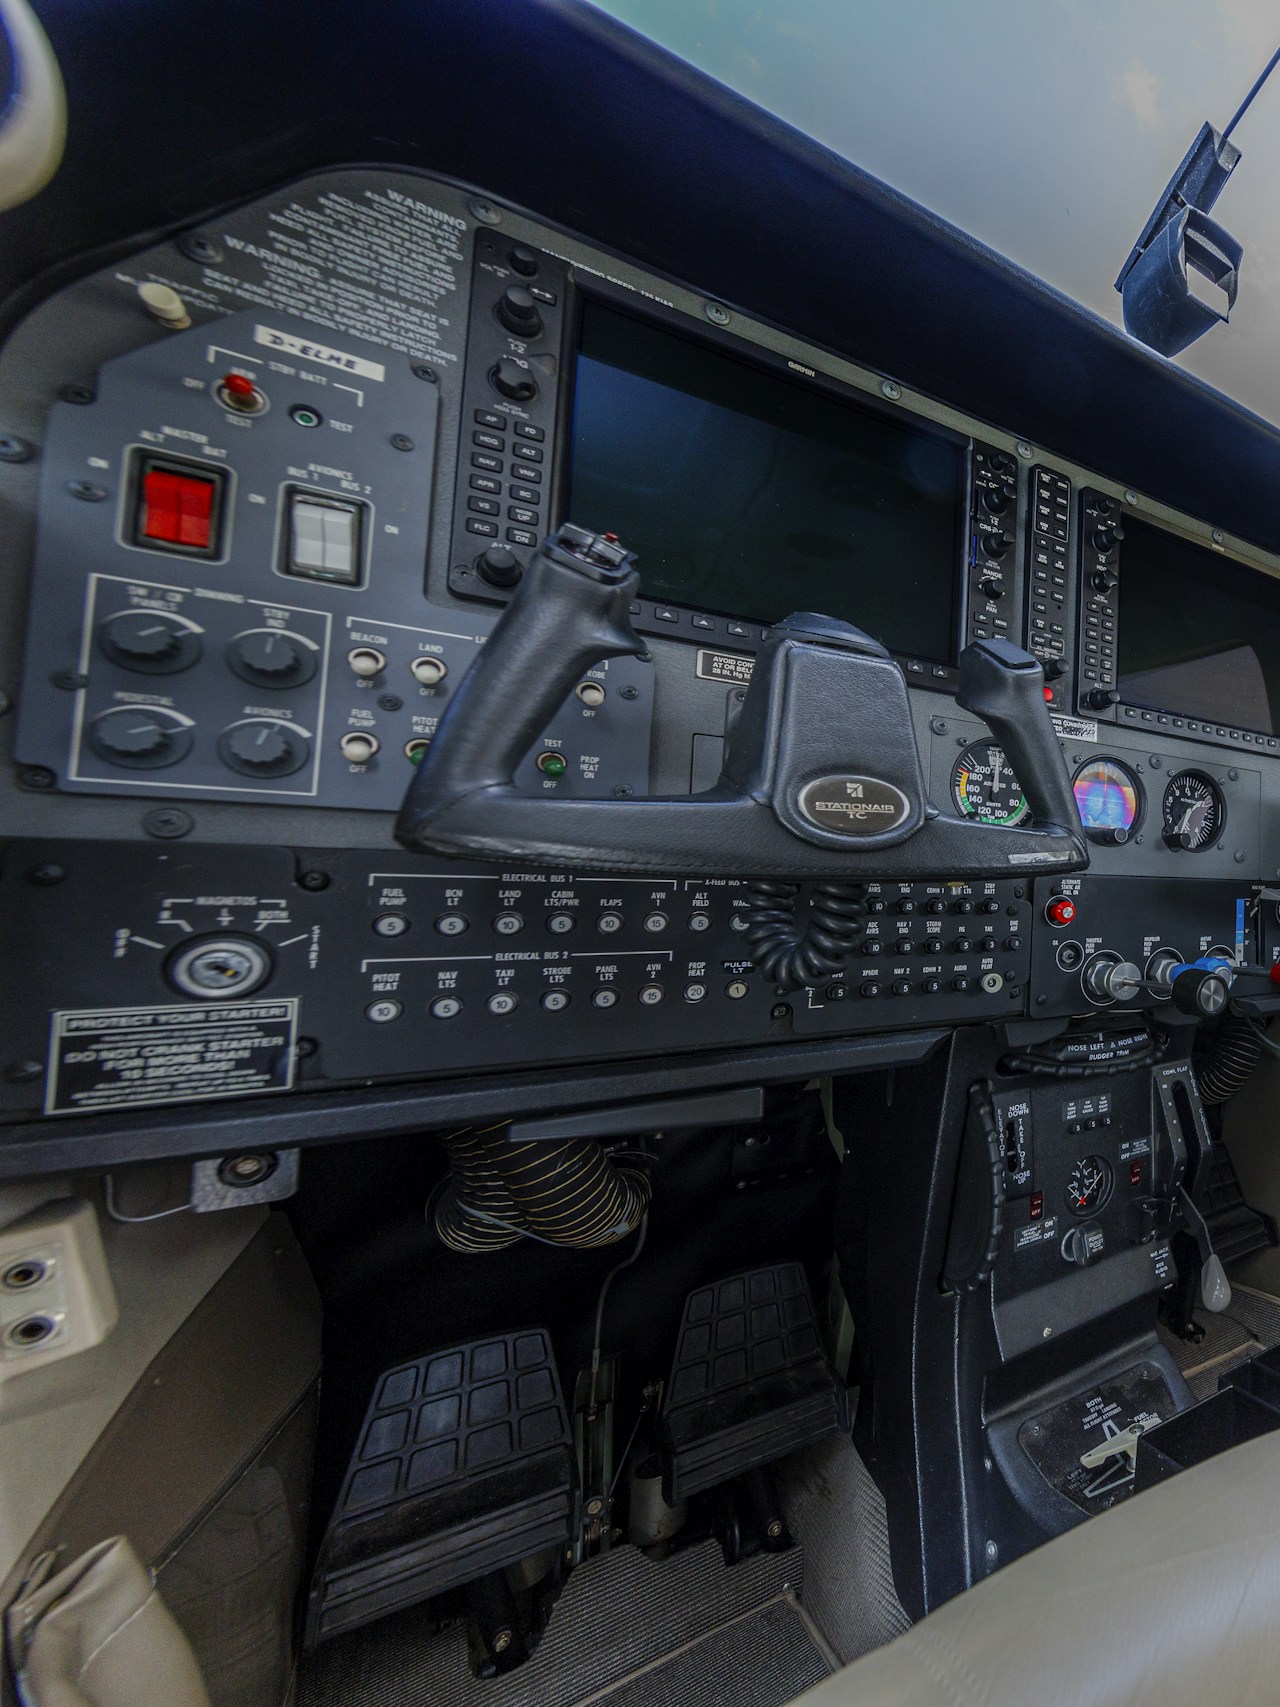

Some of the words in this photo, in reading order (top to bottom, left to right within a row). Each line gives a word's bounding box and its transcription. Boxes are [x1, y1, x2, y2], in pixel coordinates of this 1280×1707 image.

[364, 190, 409, 215] ASSURE
[413, 210, 440, 228] THAT
[442, 221, 462, 237] ALL
[387, 189, 466, 232] WARNING
[329, 192, 391, 224] INCLUDING
[436, 236, 458, 251] ARE
[318, 196, 377, 227] REMOVED
[379, 220, 410, 241] FROM
[412, 234, 440, 252] FUEL
[441, 246, 464, 262] AND
[324, 207, 356, 227] FUEL
[359, 222, 402, 246] SYSTEM
[404, 240, 447, 264] BEFORE
[308, 236, 335, 253] AND
[342, 223, 391, 250] FAILURE
[410, 251, 452, 275] ASSURE
[333, 237, 376, 261] SAFETY
[378, 254, 457, 293] INSTRUCTIONS
[372, 244, 399, 261] FREE
[400, 255, 428, 273] FUEL
[430, 266, 456, 284] AND
[290, 247, 334, 271] BODILY
[336, 264, 379, 288] INJURY
[400, 288, 437, 310] DEATH.
[329, 253, 369, 275] FLIGHT
[371, 269, 395, 285] CAN
[398, 279, 440, 302] RESULT
[332, 285, 384, 313] POSITION
[386, 305, 421, 326] PRIOR
[379, 295, 406, 312] THAT
[408, 305, 436, 323] SEAT
[339, 305, 399, 335] PROPERLY
[400, 327, 436, 348] LATCH
[333, 312, 377, 336] SAFETY
[379, 327, 457, 366] INSTRUCTIONS
[270, 333, 357, 370] D-ELME
[348, 325, 389, 350] INJURY
[409, 347, 448, 369] DEATH.
[788, 360, 815, 378] GARMIN
[300, 370, 328, 386] BATT
[329, 419, 353, 434] TEST
[161, 425, 208, 445] MASTER
[480, 435, 498, 446] HDG
[202, 445, 227, 459] BAT
[521, 447, 536, 456] ALT
[479, 457, 496, 467] NAV
[308, 462, 353, 481] AVIONICS
[477, 478, 494, 488] APR
[386, 525, 398, 535] ON
[983, 569, 1003, 580] RANGE
[263, 607, 291, 621] STBY
[986, 606, 998, 614] PAN
[350, 631, 388, 646] BEACON
[418, 642, 443, 654] LAND
[713, 656, 736, 665] AVOID
[356, 679, 374, 689] OFF
[419, 687, 436, 697] OFF
[113, 690, 176, 708] PEDESTAL
[243, 704, 293, 720] AVIONICS
[351, 709, 373, 719] FUEL
[583, 709, 596, 718] OFF
[348, 717, 376, 728] PUMP
[412, 715, 439, 727] PITOT
[412, 724, 437, 734] HEAT
[544, 739, 562, 749] TEST
[580, 755, 599, 765] PROP
[349, 764, 367, 774] OFF
[580, 763, 599, 772] HEAT
[975, 765, 991, 774] 200
[1002, 767, 1014, 776] 40
[584, 771, 595, 780] ON
[969, 773, 983, 781] 180
[543, 780, 557, 789] OFF
[967, 785, 980, 793] 160
[968, 795, 982, 804] 140
[1009, 799, 1019, 807] 80
[815, 800, 894, 812] STATIONAIR
[978, 806, 991, 815] 120
[846, 810, 867, 819] TC
[995, 809, 1008, 818] 100
[501, 874, 547, 882] ELECTRICAL
[382, 888, 405, 897] FUEL
[445, 889, 463, 897] BCN
[499, 890, 522, 898] LAND
[551, 890, 574, 898] CABIN
[195, 896, 258, 906] MAGNETOS
[379, 897, 407, 906] PUMP
[447, 897, 460, 906] LT
[503, 898, 515, 906] LT
[544, 898, 579, 906] LTS/PWR
[692, 899, 709, 907] FIELD
[258, 910, 289, 920] BOTH
[495, 952, 540, 961] ELECTRICAL
[495, 969, 515, 977] TAXI
[543, 966, 572, 975] STROBE
[596, 965, 618, 973] PANEL
[372, 973, 401, 982] PITOT
[437, 971, 458, 980] NAV
[549, 975, 564, 983] LTS
[600, 973, 613, 981] LTS
[372, 982, 399, 991] HEAT
[438, 980, 456, 989] LTS
[498, 978, 510, 986] LT
[67, 1015, 155, 1030] PROTECT
[158, 1011, 205, 1024] YOUR
[207, 1006, 286, 1021] STARTER!
[1118, 1038, 1133, 1046] NOSE
[63, 1051, 96, 1064] DO
[98, 1048, 138, 1060] NOT
[140, 1043, 205, 1058] CRANK
[208, 1036, 285, 1052] STARTER
[1068, 1044, 1087, 1052] NOSE
[1090, 1043, 1105, 1051] LEFT
[102, 1059, 144, 1071] FOR
[146, 1053, 200, 1067] MORE
[203, 1049, 251, 1061] THAN
[1089, 1052, 1114, 1061] RUDDER
[1116, 1049, 1130, 1058] TRIM
[145, 1061, 236, 1077] SECONDS!
[1009, 1103, 1027, 1111] NOSE
[1008, 1109, 1029, 1118] DOWN
[997, 1109, 1006, 1158] ELEVATOR
[1012, 1170, 1030, 1179] NOSE
[1086, 1396, 1102, 1408] BOTH
[1134, 1411, 1148, 1423] FUEL
